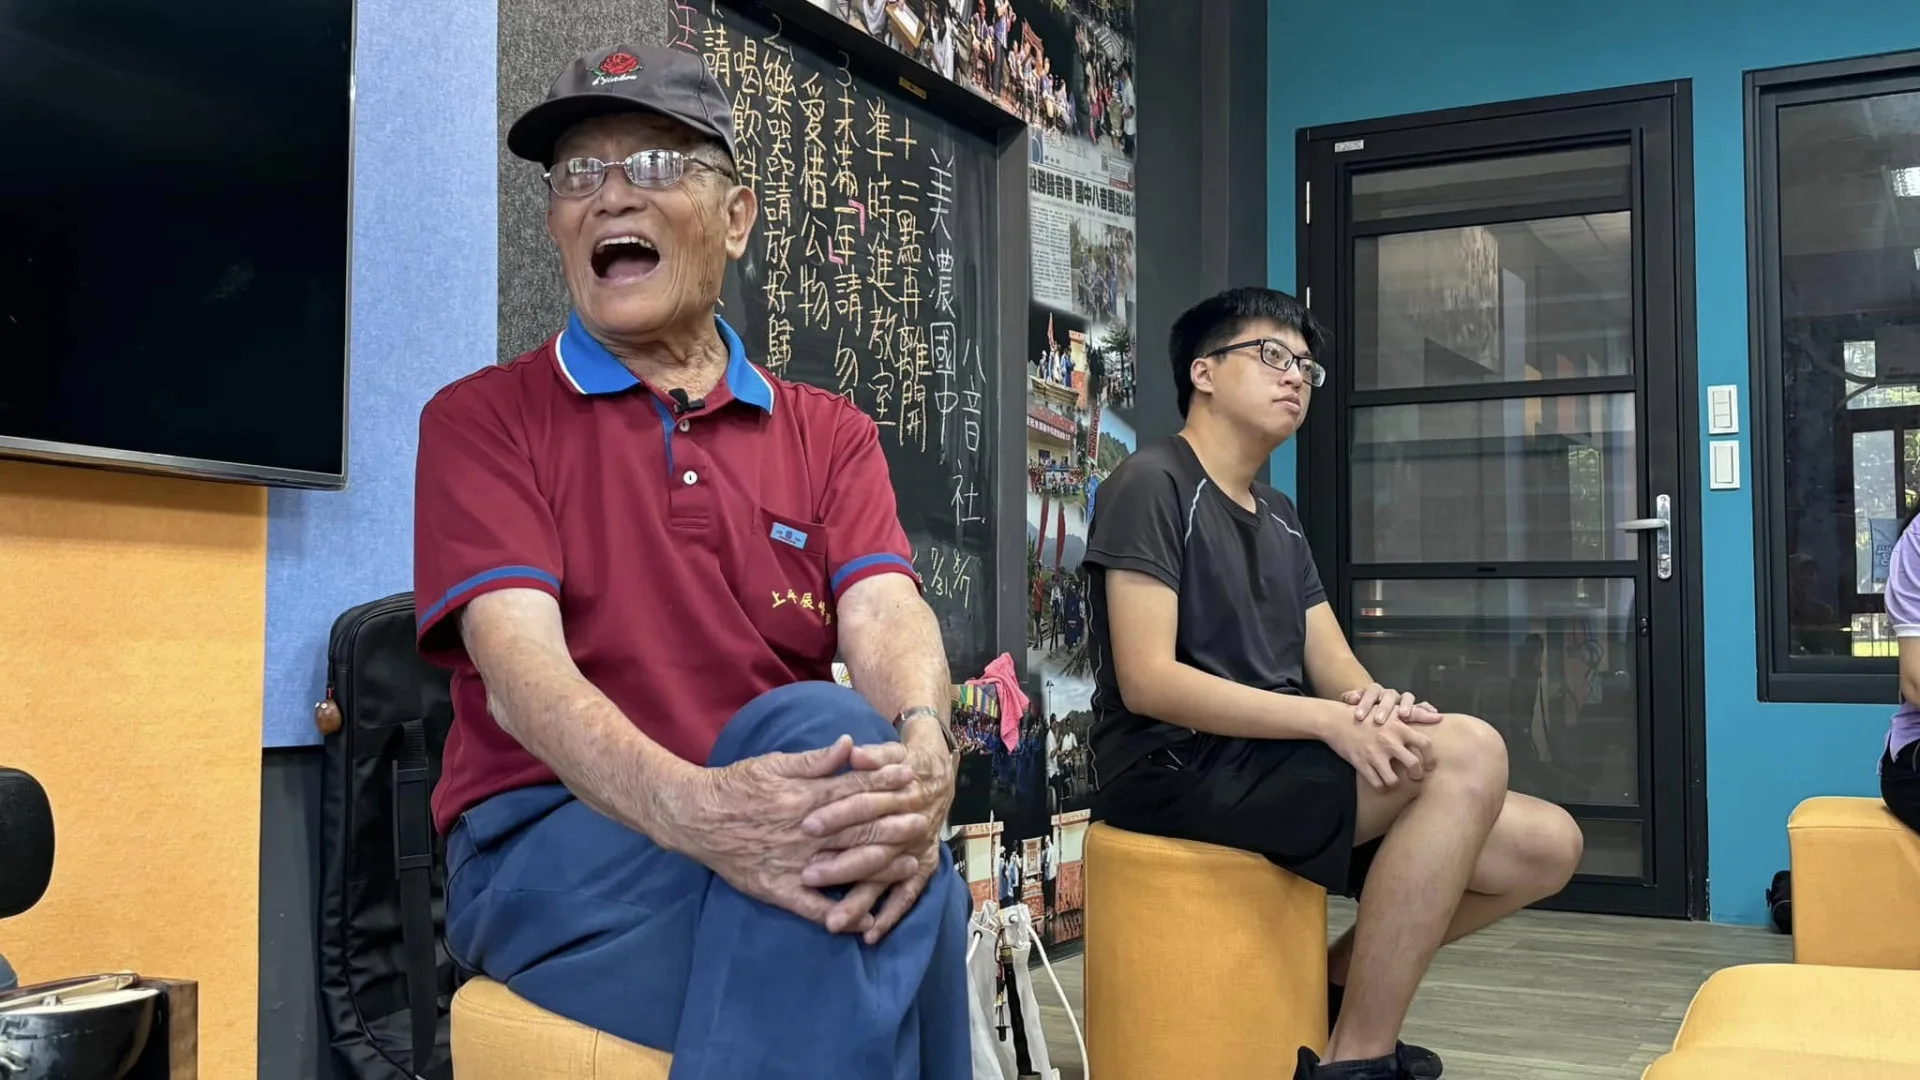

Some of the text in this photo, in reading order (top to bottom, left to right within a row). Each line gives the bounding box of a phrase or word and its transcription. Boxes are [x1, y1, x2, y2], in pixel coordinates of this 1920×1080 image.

[896, 119, 933, 453] 十二點再離開
[926, 147, 959, 447] 美濃國中
